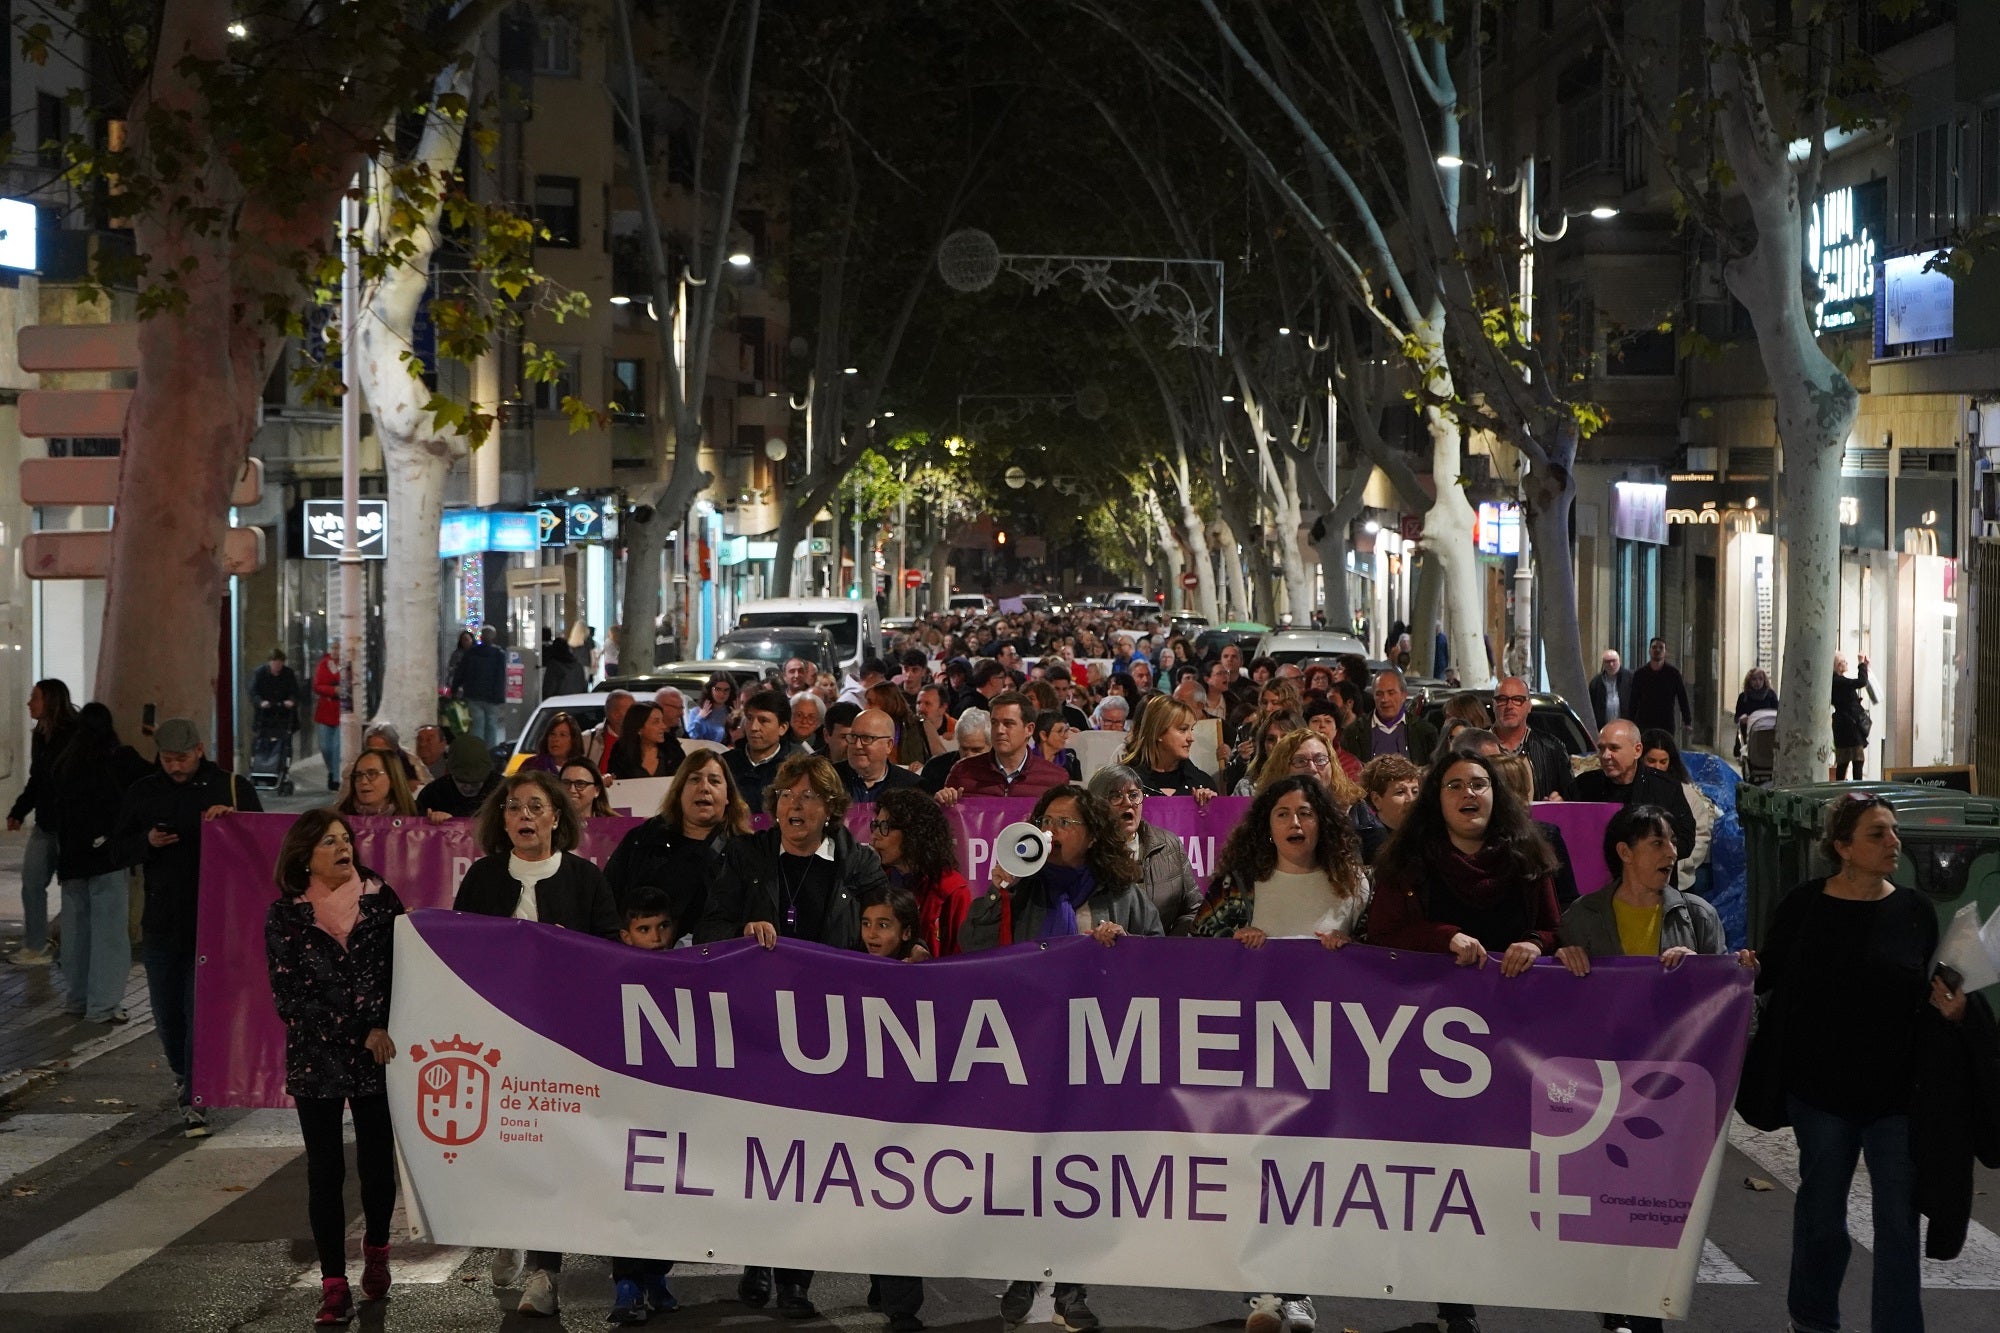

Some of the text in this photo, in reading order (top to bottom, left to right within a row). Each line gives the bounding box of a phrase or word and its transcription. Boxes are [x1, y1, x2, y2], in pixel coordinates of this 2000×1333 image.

[620, 983, 1493, 1100] NI UNA MENYS
[501, 1076, 601, 1098] Ajuntament
[500, 1095, 582, 1113] de Xàtiva
[500, 1117, 538, 1127] Dona i
[500, 1131, 543, 1143] Igualtat
[624, 1128, 1486, 1236] EL MASCLISME MATA
[1600, 1194, 1692, 1209] Consell de les Don
[1630, 1213, 1648, 1223] per
[1649, 1212, 1660, 1222] la
